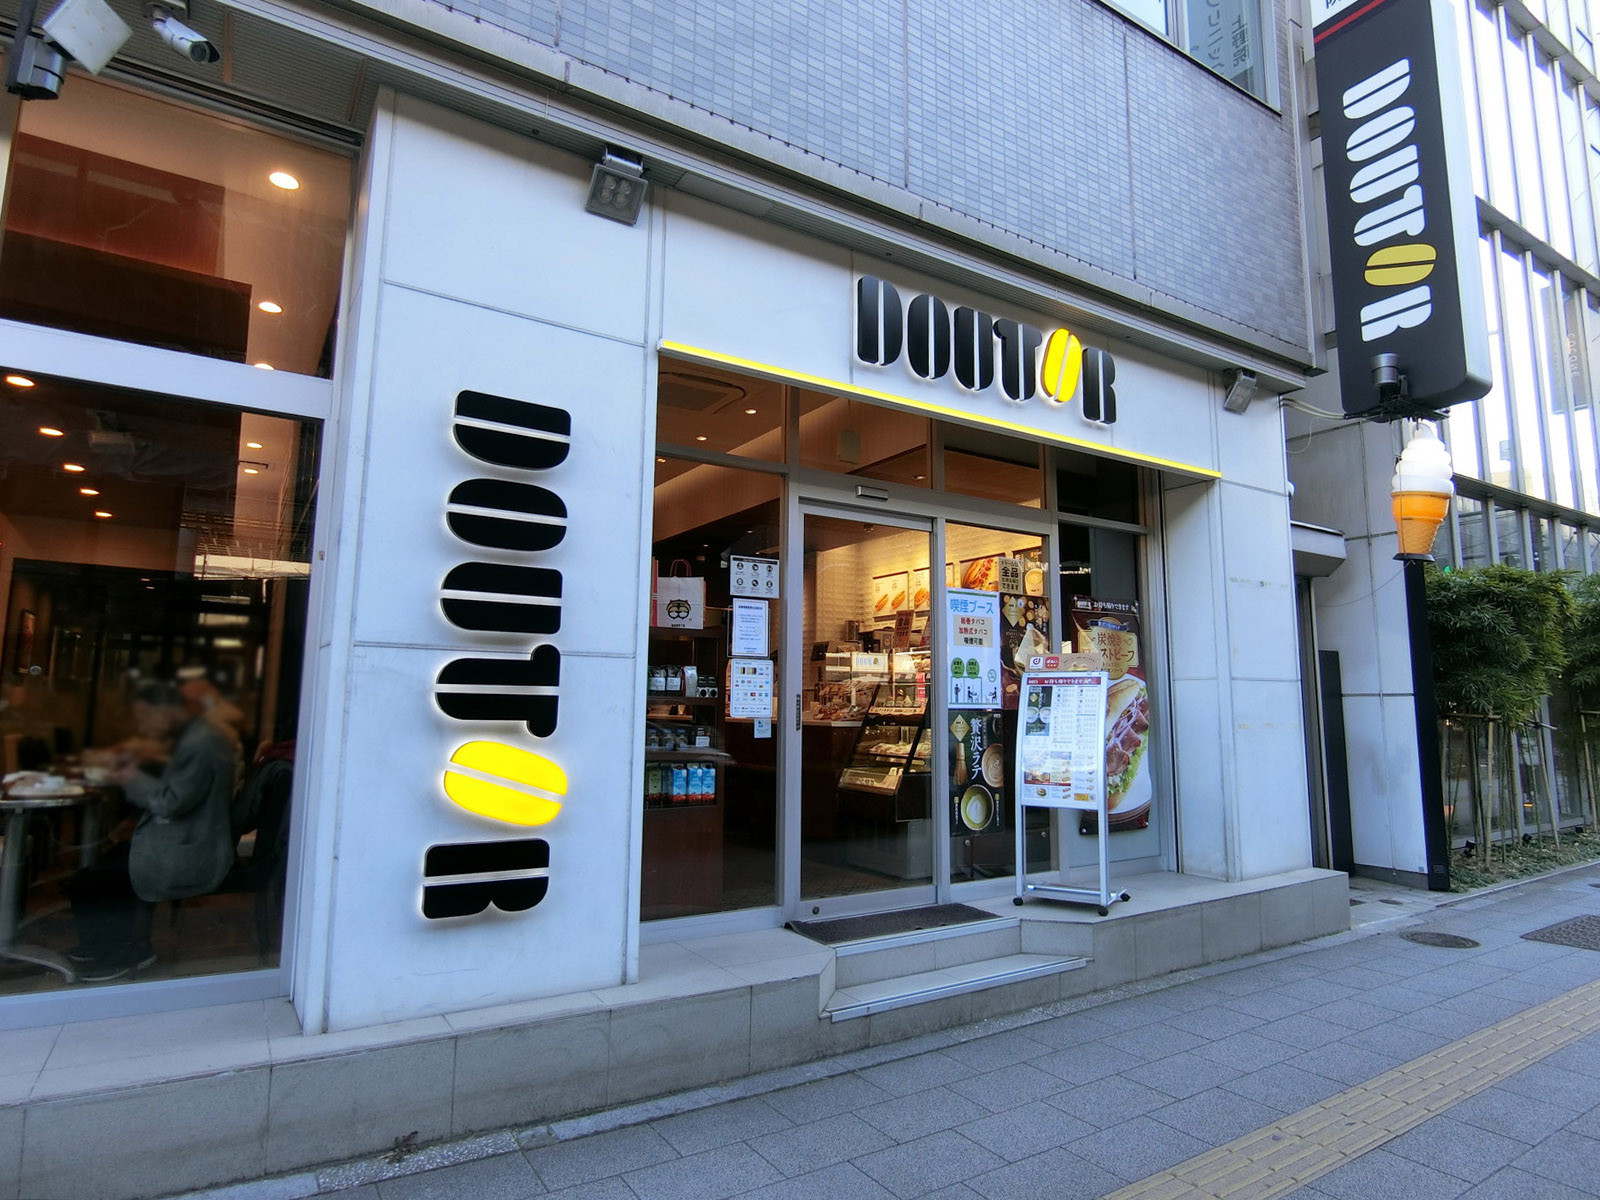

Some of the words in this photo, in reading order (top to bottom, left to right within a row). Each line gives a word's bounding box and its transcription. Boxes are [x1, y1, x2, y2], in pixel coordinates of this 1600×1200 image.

[1343, 58, 1437, 341] DOUTOR
[857, 275, 1117, 425] DOUTOR
[1001, 565, 1018, 578] 全品
[950, 598, 994, 614] 喫煙ブース
[421, 389, 571, 920] DOUTOR
[1097, 632, 1122, 647] 炭焼き
[970, 718, 983, 780] 贅沢ラテ
